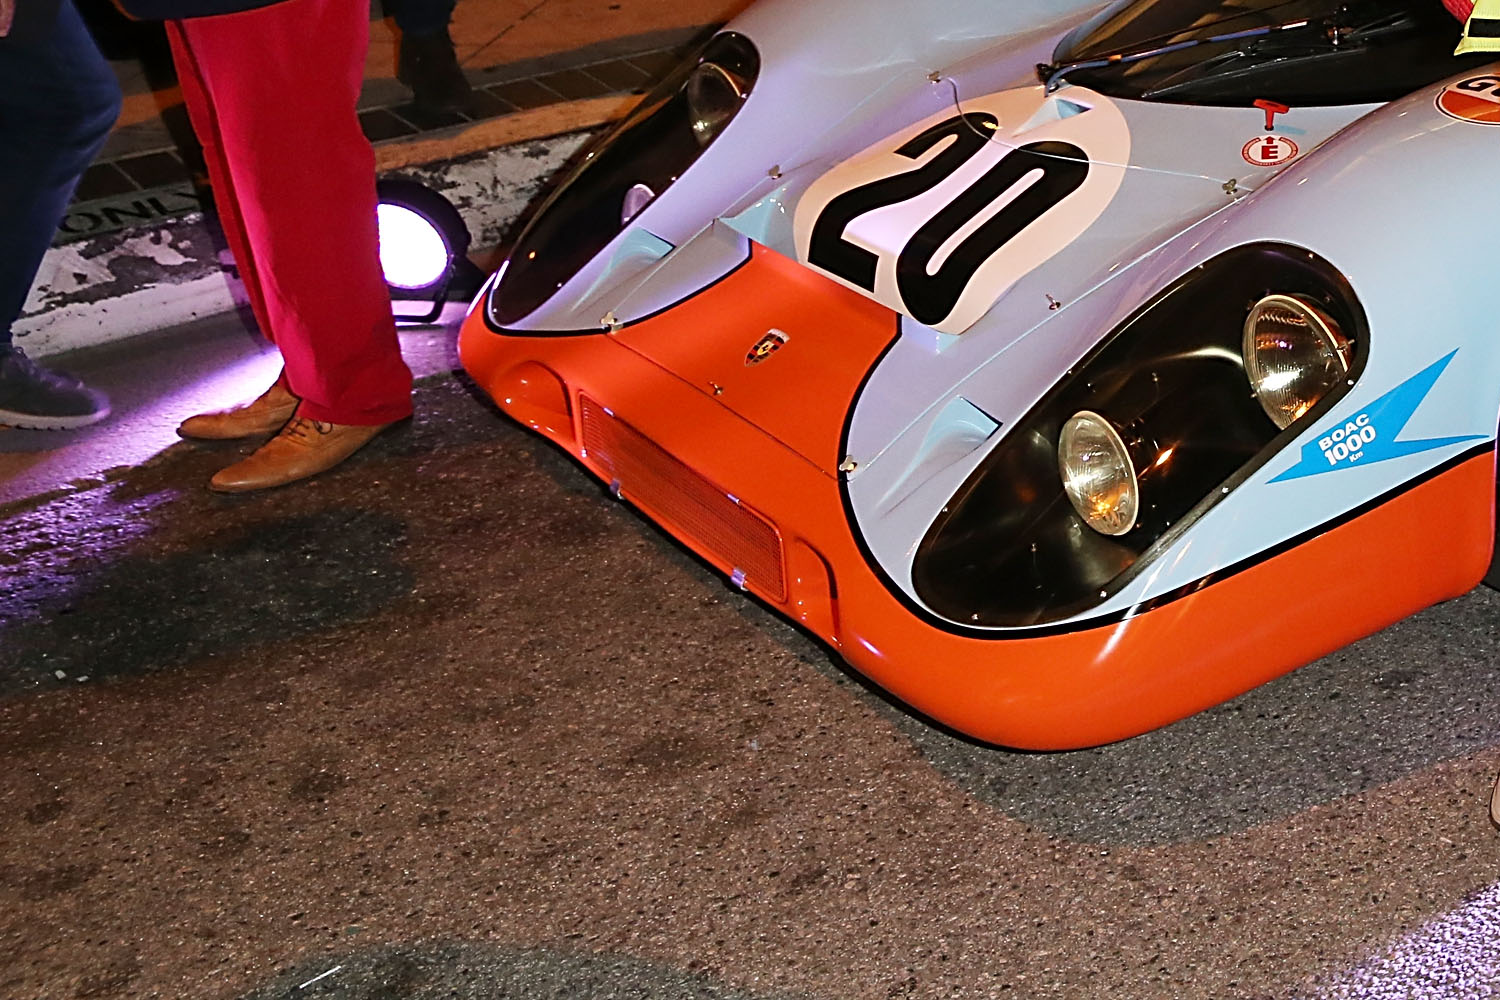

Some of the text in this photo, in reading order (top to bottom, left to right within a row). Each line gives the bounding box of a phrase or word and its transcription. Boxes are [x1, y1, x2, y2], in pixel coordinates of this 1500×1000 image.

[1261, 145, 1278, 160] E
[807, 111, 1090, 325] 20
[1318, 413, 1370, 451] BOAC
[1324, 425, 1377, 466] 1000
[1349, 451, 1364, 462] Km
